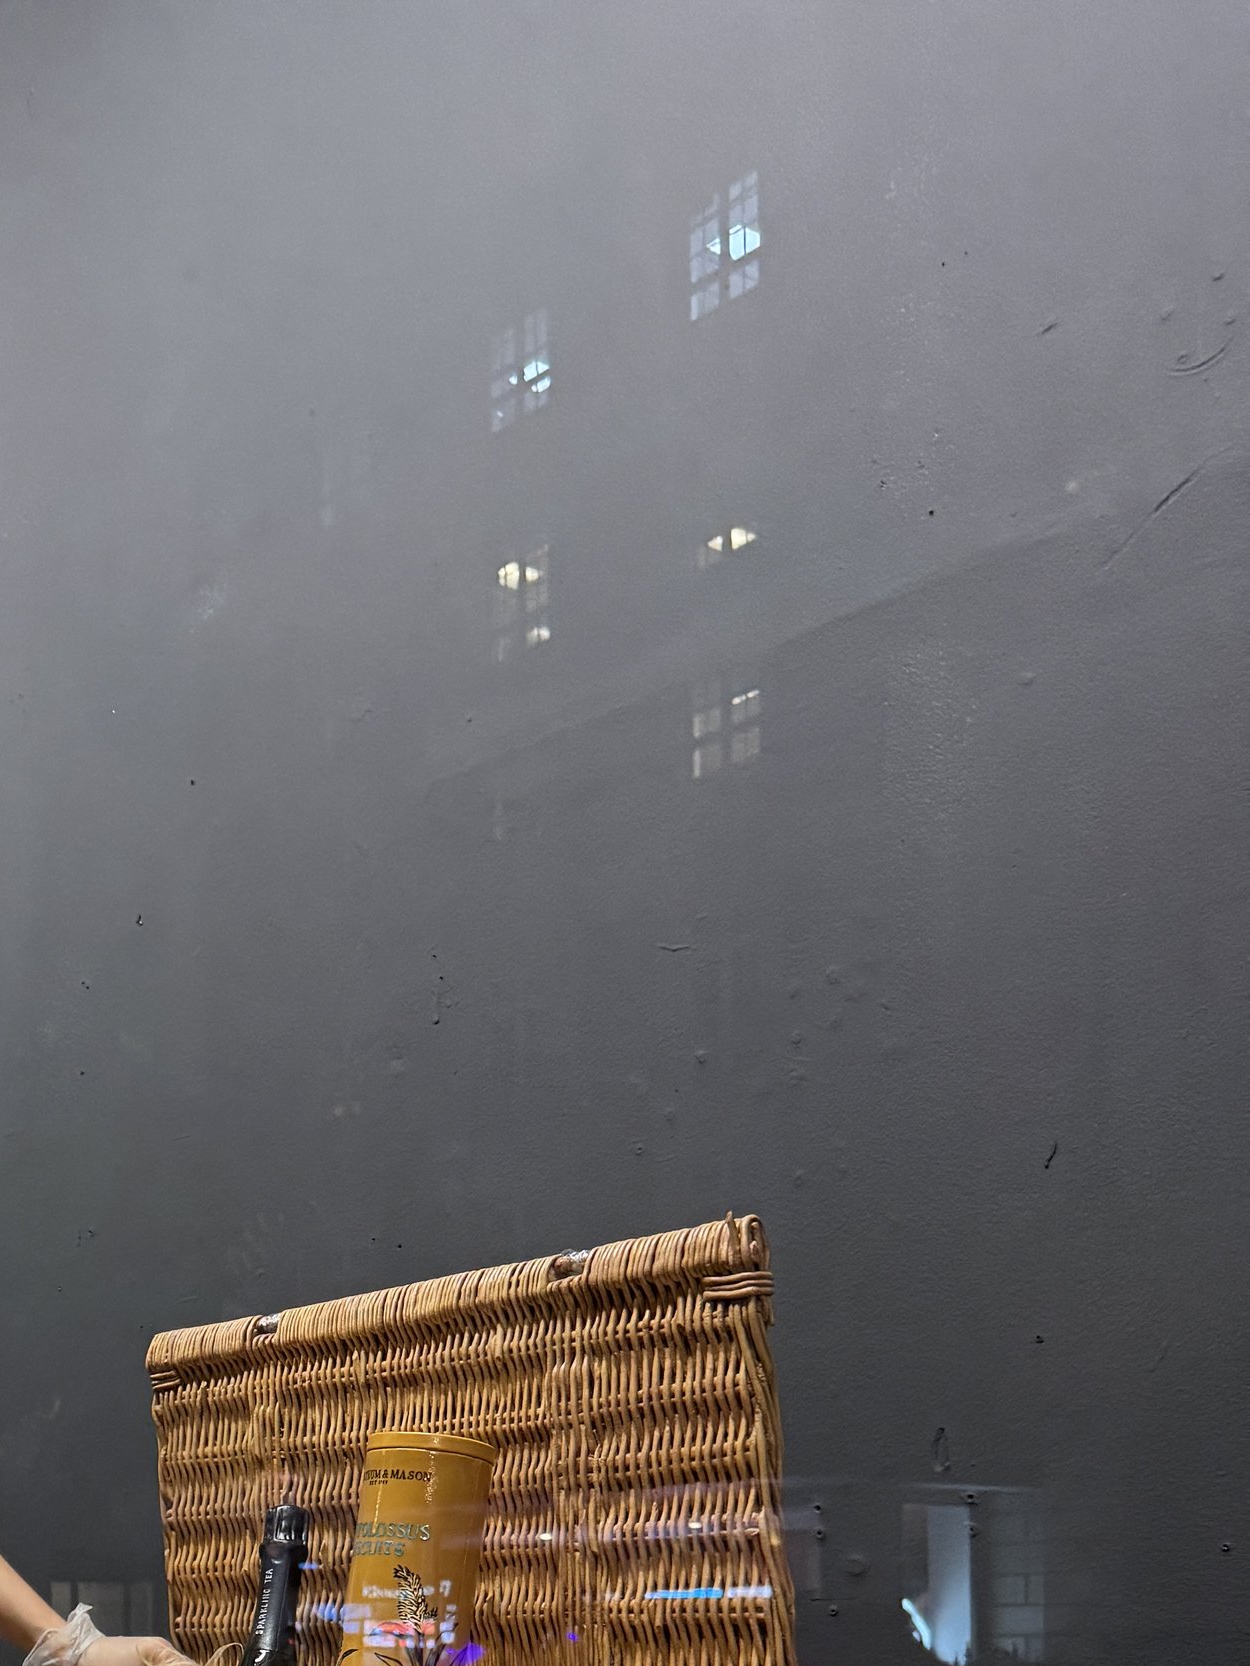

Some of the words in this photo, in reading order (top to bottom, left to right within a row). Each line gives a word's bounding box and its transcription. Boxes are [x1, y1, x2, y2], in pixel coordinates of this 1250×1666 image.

[382, 1469, 389, 1479] &
[390, 1469, 432, 1482] MASON
[255, 1588, 271, 1635] SPARKLING
[264, 1568, 274, 1584] TEA
